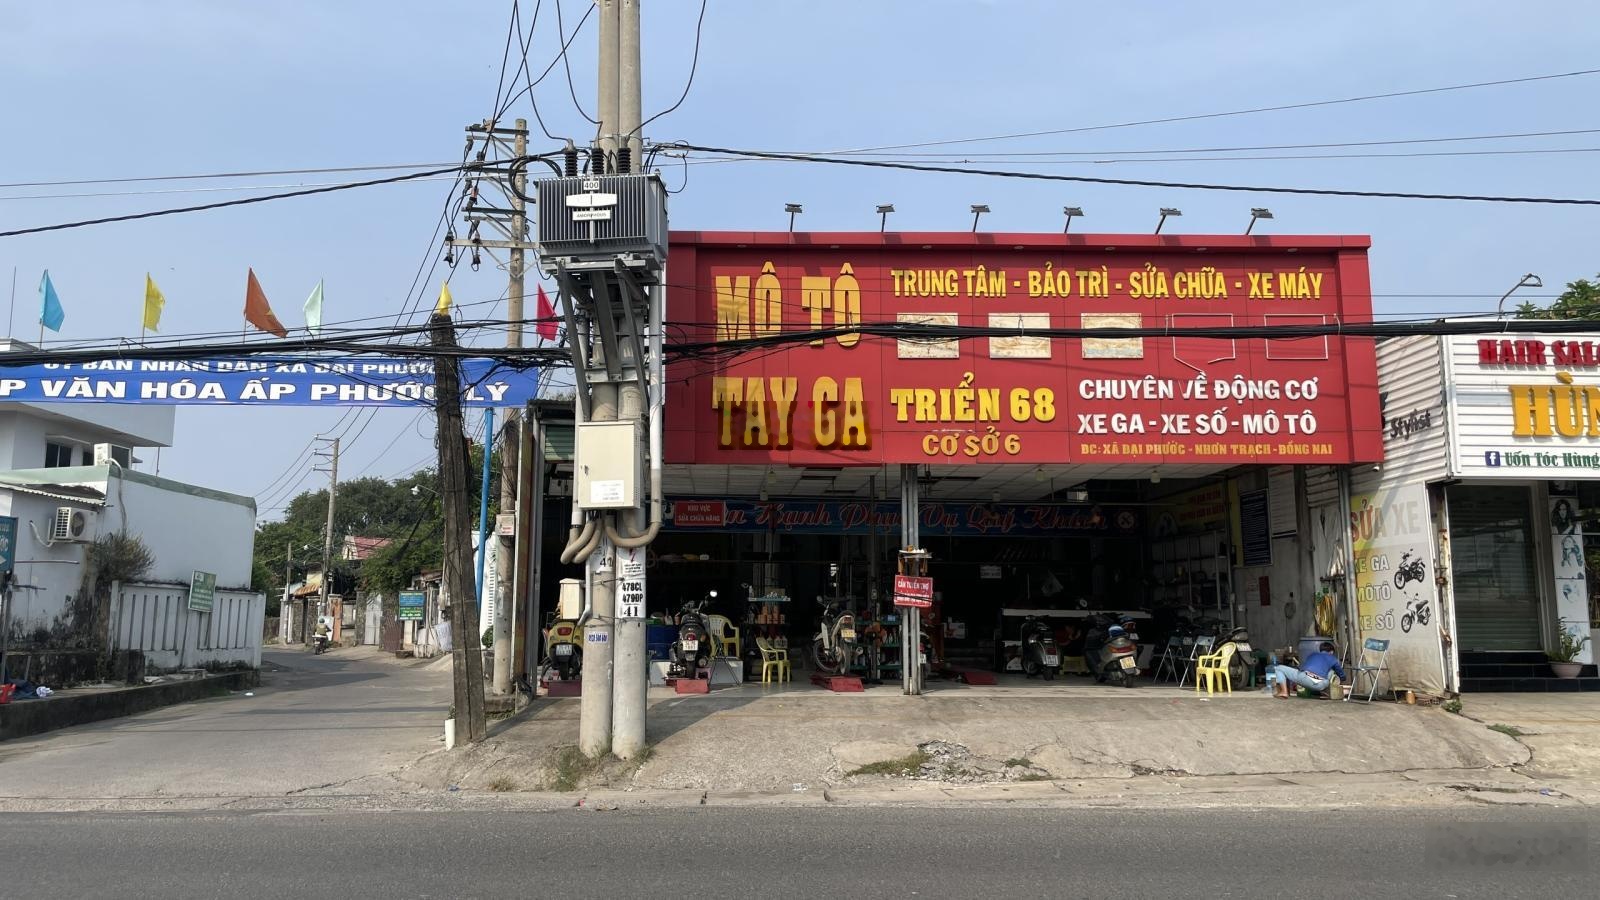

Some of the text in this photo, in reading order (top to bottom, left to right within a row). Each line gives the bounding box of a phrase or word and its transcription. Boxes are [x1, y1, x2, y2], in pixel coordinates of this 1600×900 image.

[584, 181, 599, 189] 400
[890, 269, 959, 297] TRUNG
[963, 265, 1007, 297] TÂM
[1028, 262, 1071, 297] BẢO
[1075, 266, 1109, 297] TRÌ
[1129, 262, 1169, 299] SỬA
[1173, 266, 1228, 299] CHỮA
[1248, 272, 1275, 299] XE
[1279, 267, 1323, 299] MÁY
[715, 261, 862, 347] MÔ TÔ
[1477, 339, 1600, 366] HAIR SAL
[41, 377, 126, 398] VĂN
[141, 378, 226, 399] HÓA
[240, 377, 296, 400] ẤP
[465, 381, 512, 401] LÝ
[890, 372, 1056, 422] TRIỂN 68
[1078, 372, 1319, 404] CHUYÊN VỀ ĐỘNG CƠ
[712, 376, 869, 449] TAY GA
[1508, 371, 1600, 437] HÙ
[1077, 414, 1107, 434] XE
[1111, 414, 1145, 434] GA
[1161, 414, 1191, 434] XE
[1195, 407, 1228, 435] SỐ
[1243, 410, 1280, 435] MÔ
[1284, 409, 1317, 435] TÔ
[1390, 408, 1431, 440] Stylist
[922, 425, 1021, 456] CƠ SỞ 6
[1103, 441, 1120, 454] XÃ
[1122, 443, 1144, 458] ĐẠI
[1145, 441, 1186, 455] PHƯỚC
[1195, 442, 1228, 455] NHƠN
[1230, 443, 1271, 458] TRẠCH
[1312, 443, 1333, 455] NAI
[1505, 450, 1531, 467] Uốn
[1534, 451, 1559, 467] Tóc
[1350, 499, 1421, 542] SỬA XE
[1371, 555, 1390, 571] GA
[622, 582, 642, 592] 478CL
[624, 606, 639, 616] 41
[1375, 608, 1395, 631] SỐ
